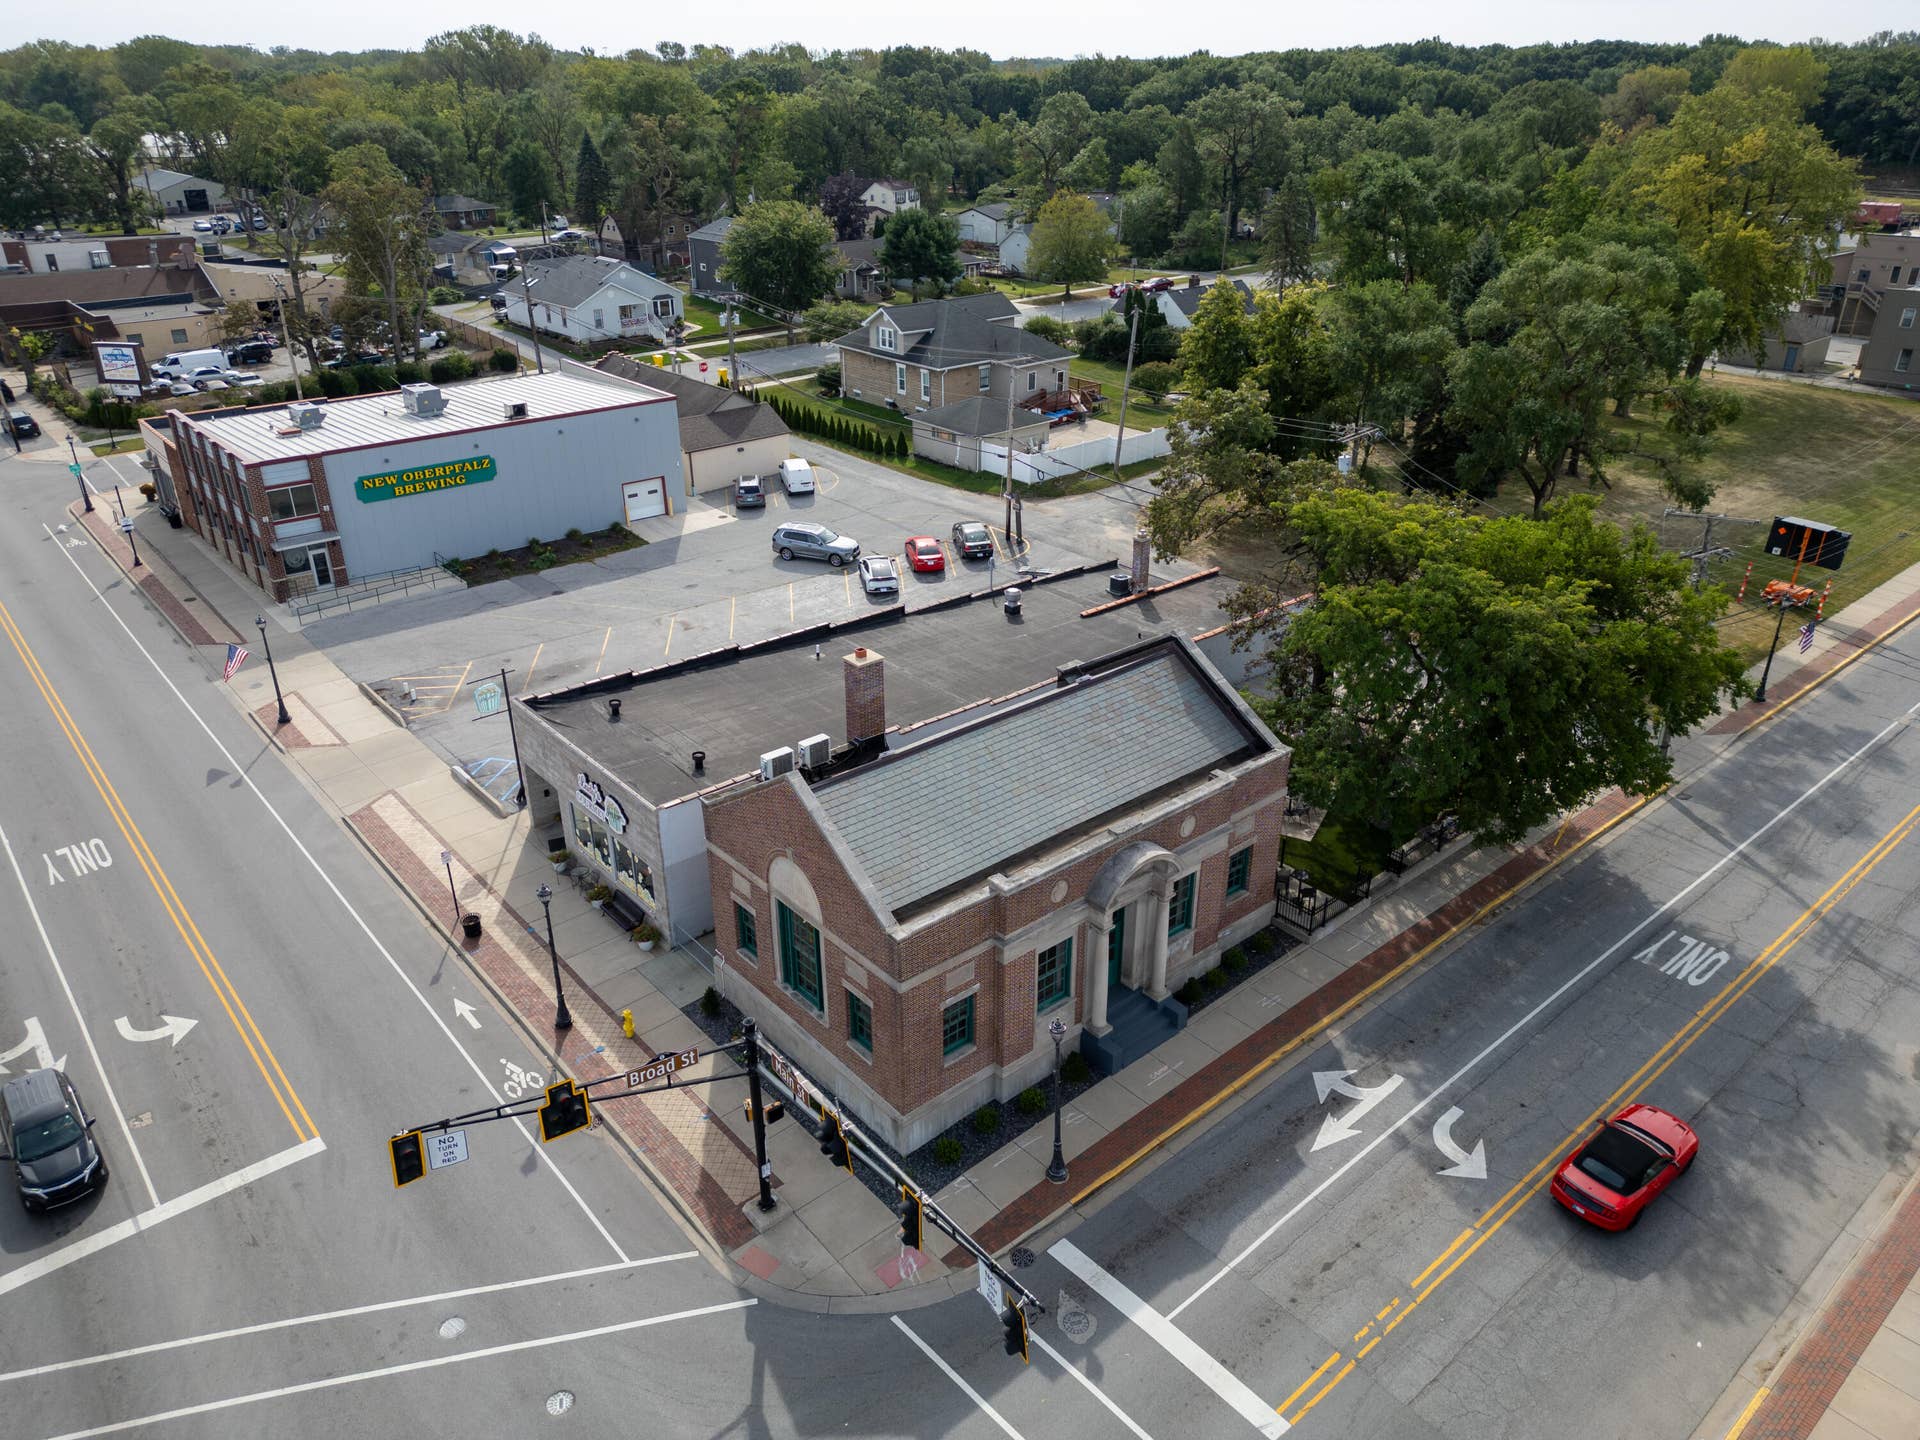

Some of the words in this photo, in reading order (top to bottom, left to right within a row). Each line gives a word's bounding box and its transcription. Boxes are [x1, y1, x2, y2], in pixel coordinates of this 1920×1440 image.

[362, 474, 398, 490] NEW
[402, 458, 491, 483] OBERPFALZ
[394, 474, 466, 497] BREWING
[42, 838, 112, 886] ONLY
[1632, 930, 1730, 986] ONLY
[630, 1057, 676, 1086] Broad
[681, 1051, 696, 1067] St
[775, 1058, 795, 1092] Main
[796, 1083, 806, 1104] St
[437, 1142, 459, 1152] TURN
[438, 1135, 455, 1146] NO
[443, 1150, 455, 1158] ON
[441, 1155, 458, 1165] RED
